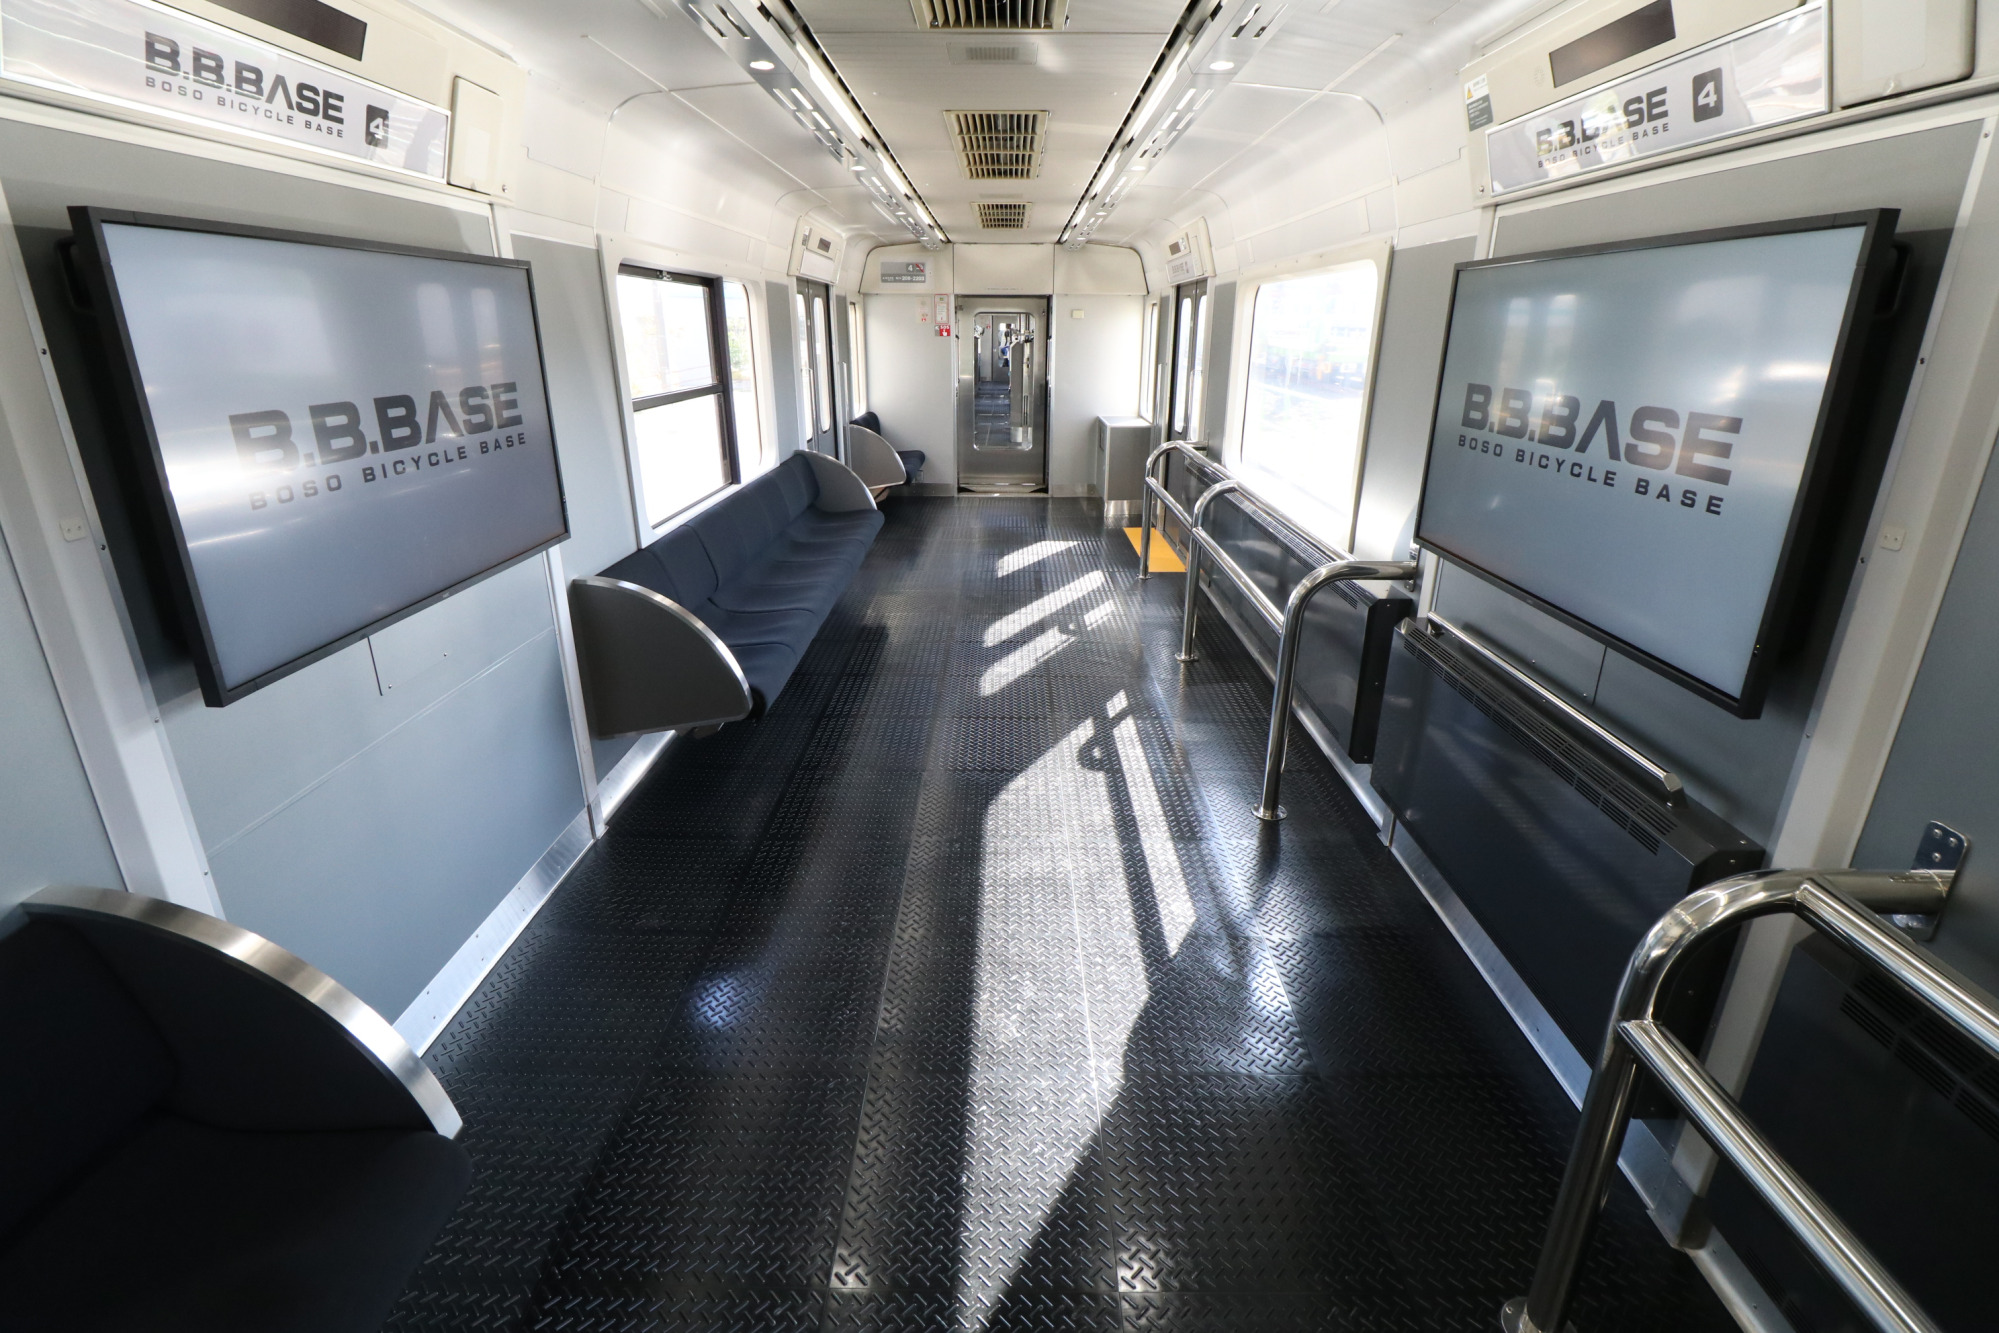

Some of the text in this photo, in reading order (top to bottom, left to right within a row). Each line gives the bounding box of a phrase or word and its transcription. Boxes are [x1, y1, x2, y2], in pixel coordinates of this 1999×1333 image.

[145, 31, 344, 125] B.B.BASE
[145, 76, 344, 138] BOSO BICYCLE BASE
[1697, 81, 1718, 108] 4
[369, 117, 384, 140] 4
[1632, 122, 1669, 140] BASE
[228, 381, 523, 474] B.B.BASE
[1460, 382, 1743, 486] B.B.BASE
[248, 432, 526, 511] BOSO BICYCLE BASE
[1458, 434, 1724, 516] BOSO BICYCLE BASE
